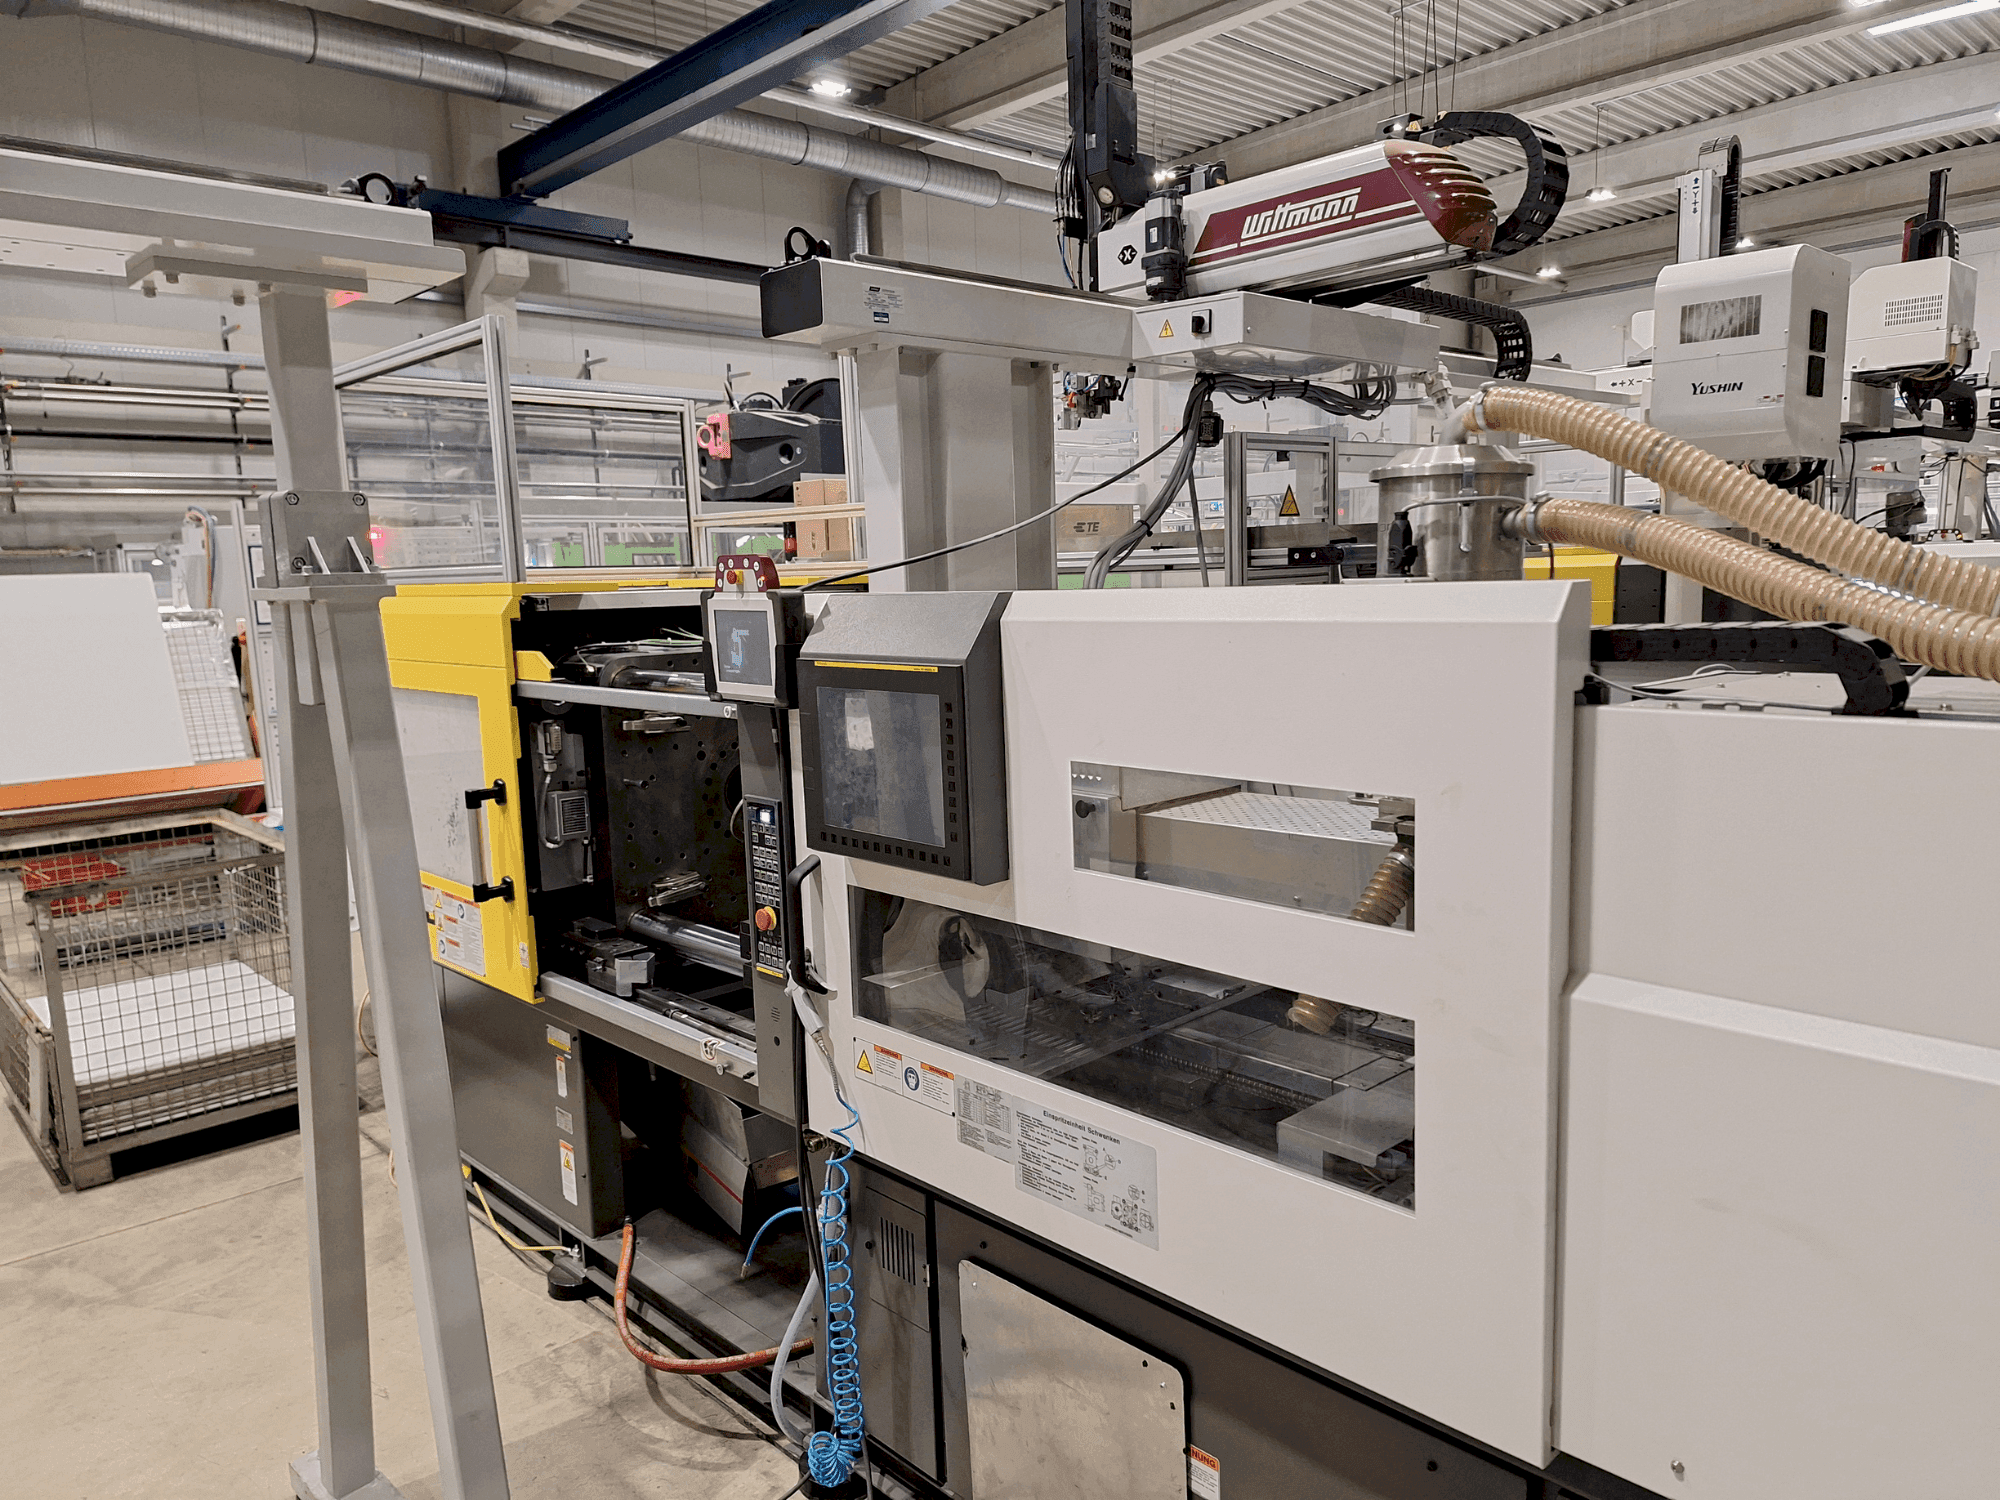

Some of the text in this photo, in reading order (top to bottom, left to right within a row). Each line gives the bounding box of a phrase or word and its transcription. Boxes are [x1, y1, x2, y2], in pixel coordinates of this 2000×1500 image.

[1241, 187, 1361, 239] Wittmann
[1087, 522, 1100, 532] TE
[1043, 1110, 1086, 1132] Einspritzeinheit
[1087, 1126, 1121, 1145] Schwenken
[1191, 1448, 1217, 1469] NUNG
